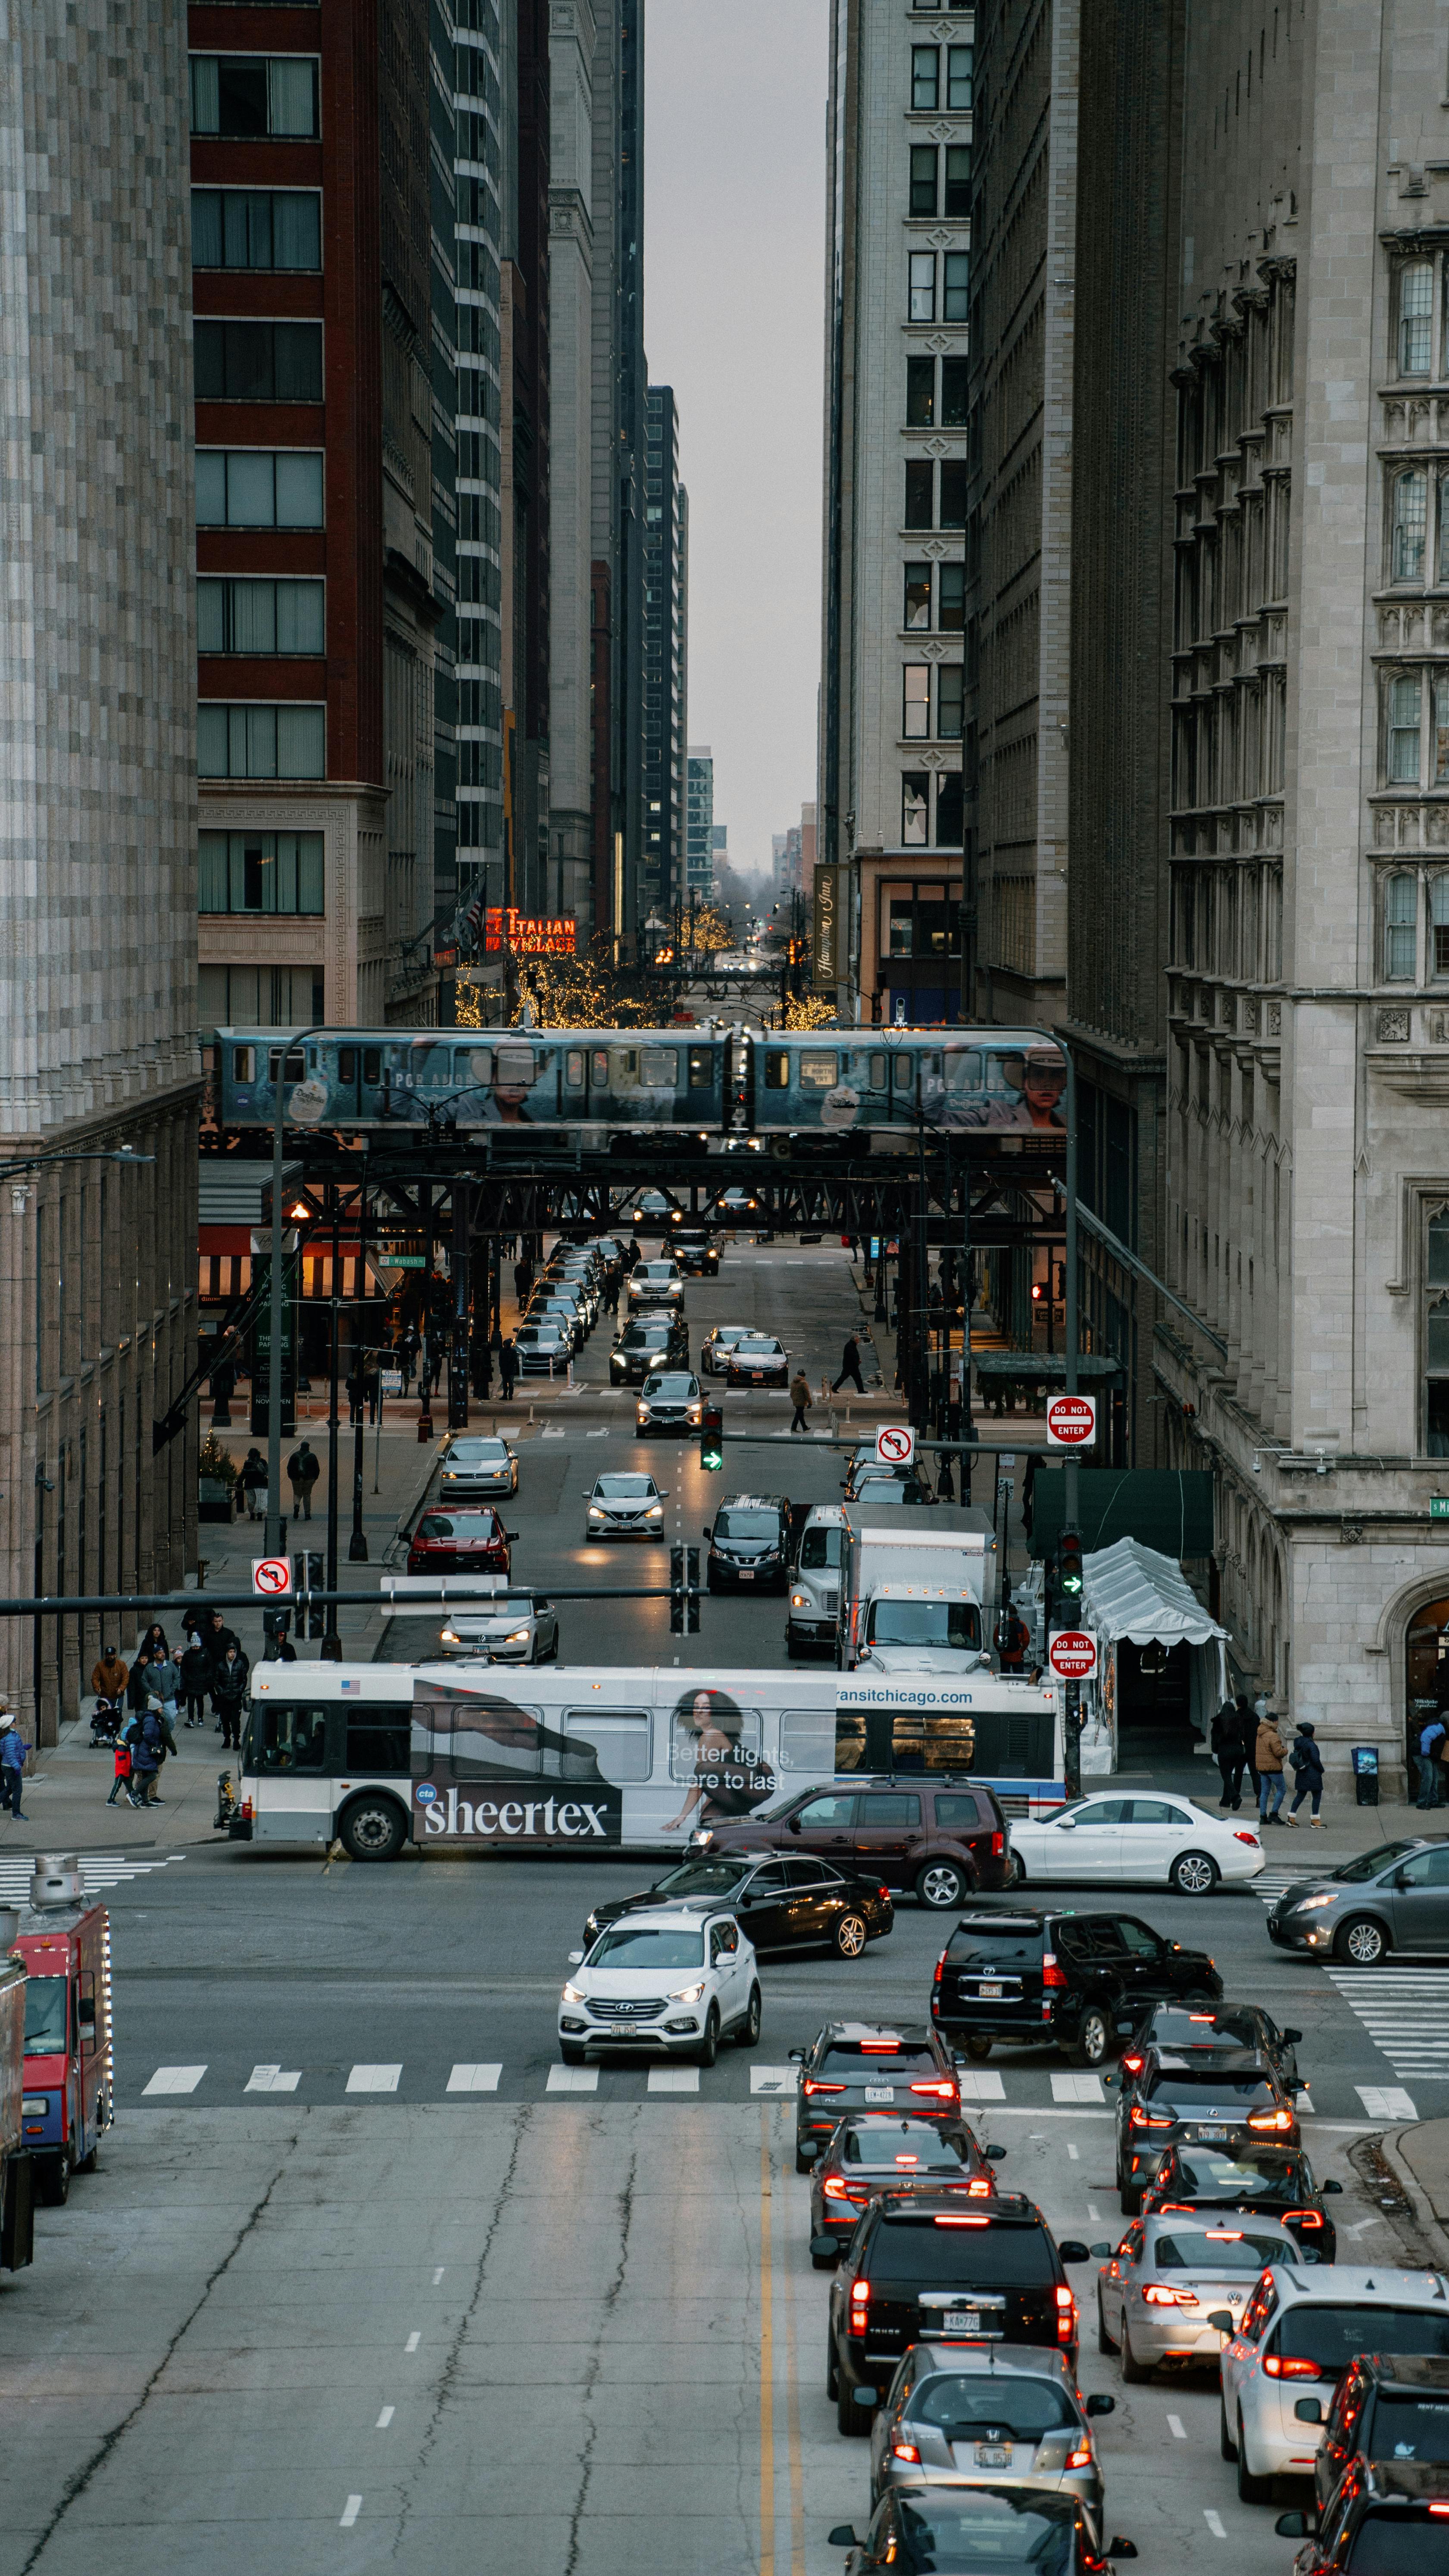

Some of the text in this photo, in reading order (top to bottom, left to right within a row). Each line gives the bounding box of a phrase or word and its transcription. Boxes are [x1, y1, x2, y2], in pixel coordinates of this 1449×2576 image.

[817, 875, 833, 978] Hampton Inn
[508, 937, 575, 952] VILLAGE
[1058, 1427, 1084, 1435] ENTER
[1073, 1641, 1089, 1649] NOT
[665, 1743, 794, 1767] Better tights,
[672, 1771, 785, 1790] here to last
[418, 1789, 433, 1798] cta
[425, 1788, 608, 1836] sheertex
